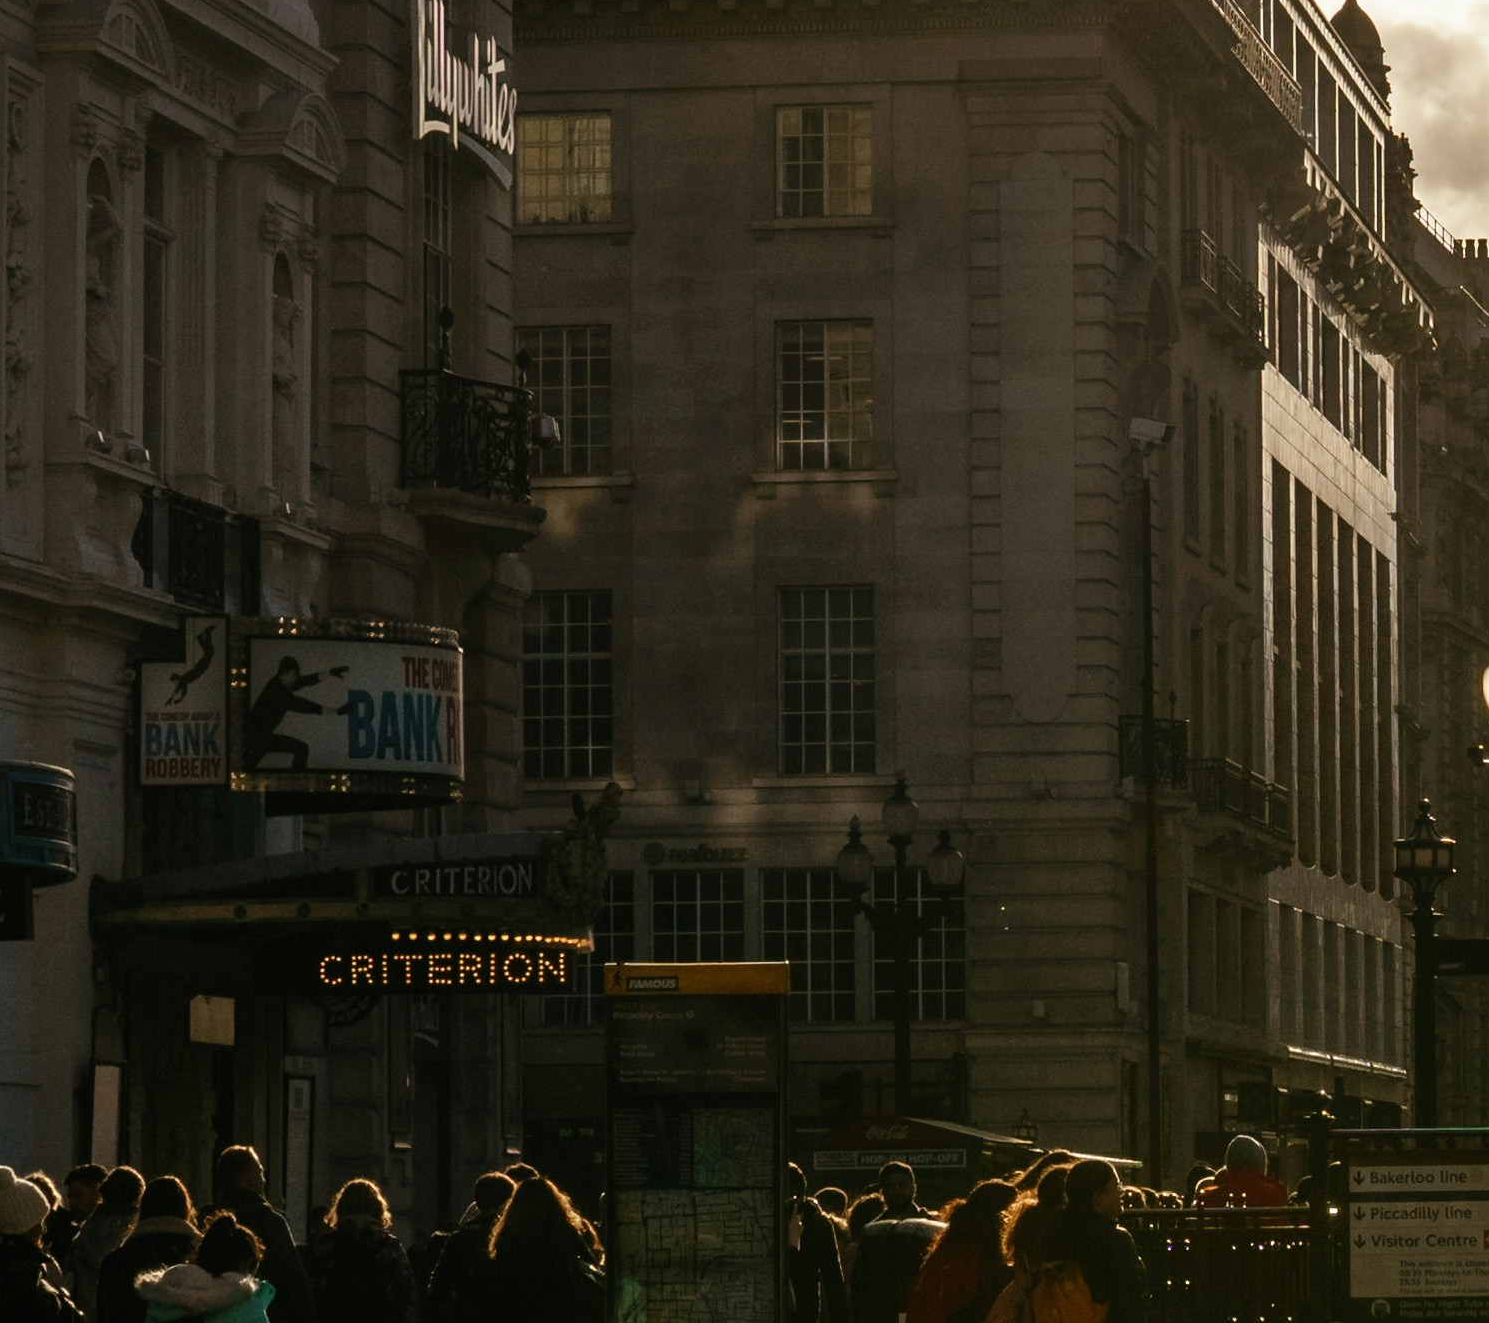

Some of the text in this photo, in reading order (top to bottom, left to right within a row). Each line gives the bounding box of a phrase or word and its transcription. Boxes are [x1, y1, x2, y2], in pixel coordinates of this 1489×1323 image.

[403, 656, 430, 688] THE
[348, 690, 443, 763] BANK
[145, 723, 221, 756] BANK
[145, 758, 221, 778] ROBBERY
[391, 864, 533, 894] CRITERION
[319, 953, 567, 985] CRITERION
[629, 978, 678, 989] FAMOUS
[1370, 1169, 1468, 1184] Bakerloo line
[1370, 1206, 1473, 1222] Piccadilly line
[1371, 1234, 1478, 1247] Visitor Centre
